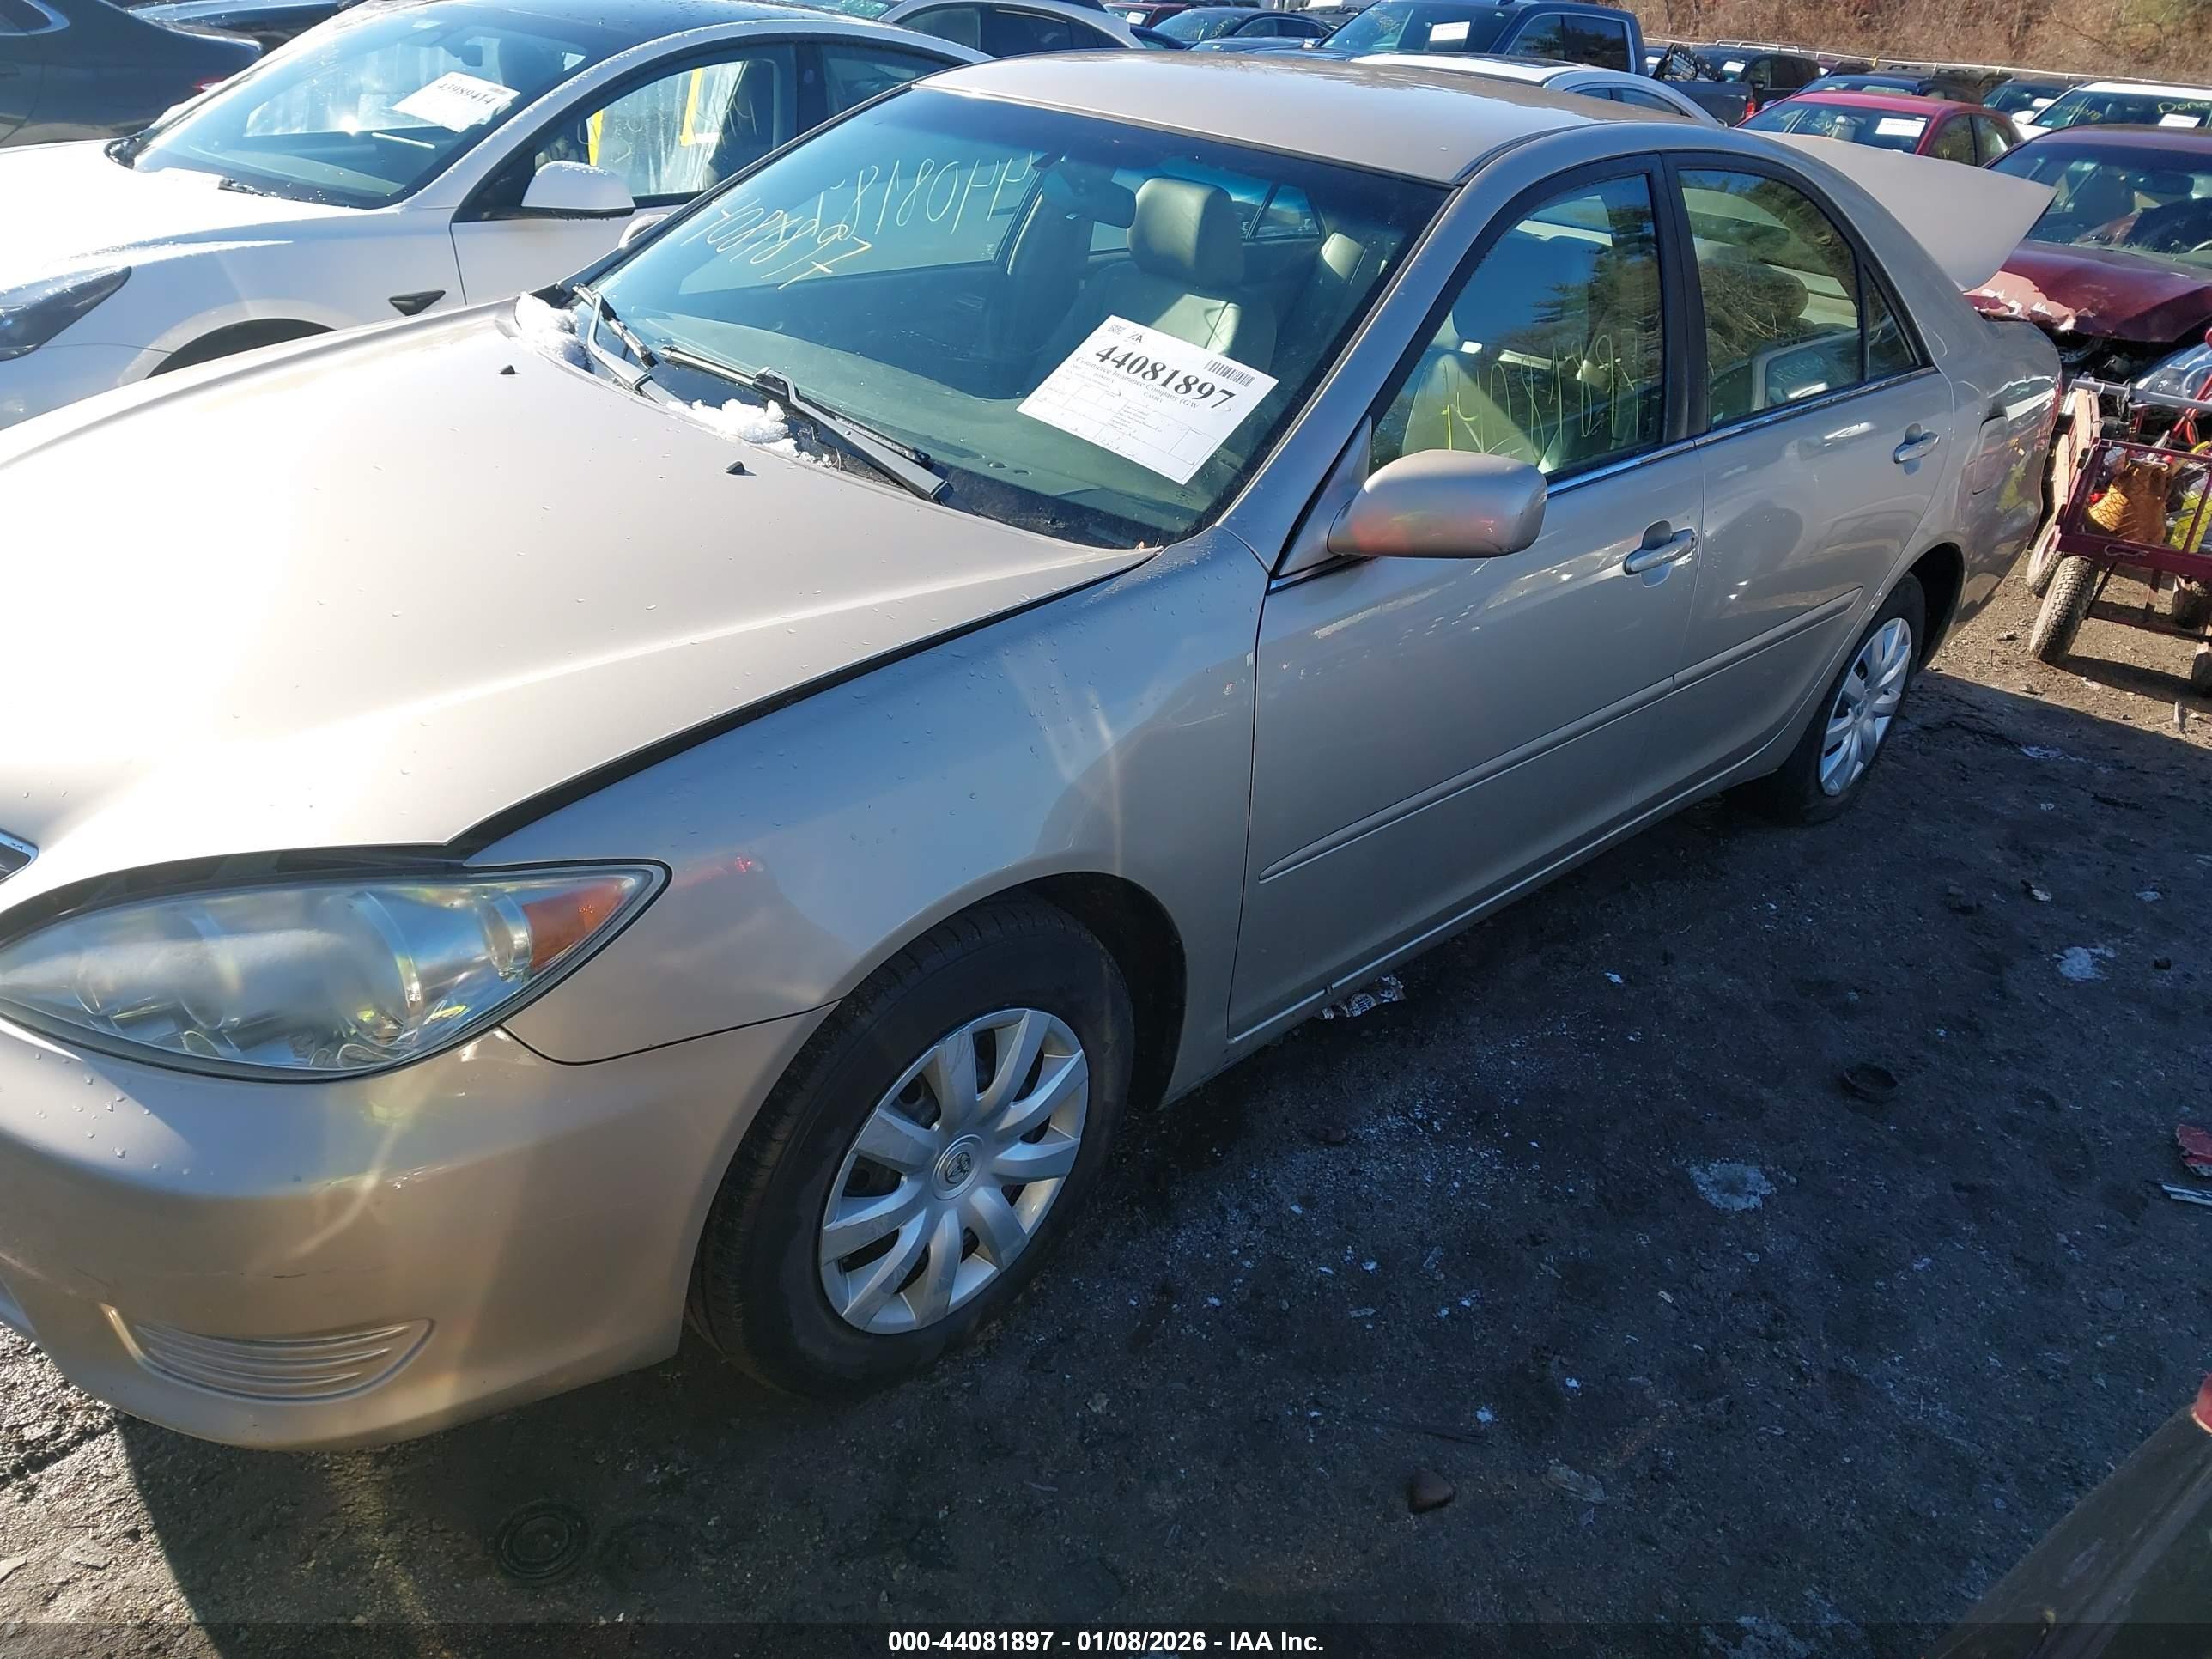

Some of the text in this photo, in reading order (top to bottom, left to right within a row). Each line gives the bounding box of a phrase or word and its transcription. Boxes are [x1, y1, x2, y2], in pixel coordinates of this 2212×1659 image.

[1095, 345, 1236, 410] 44081897
[1112, 370, 1146, 387] Insurance
[1146, 384, 1180, 401] Company
